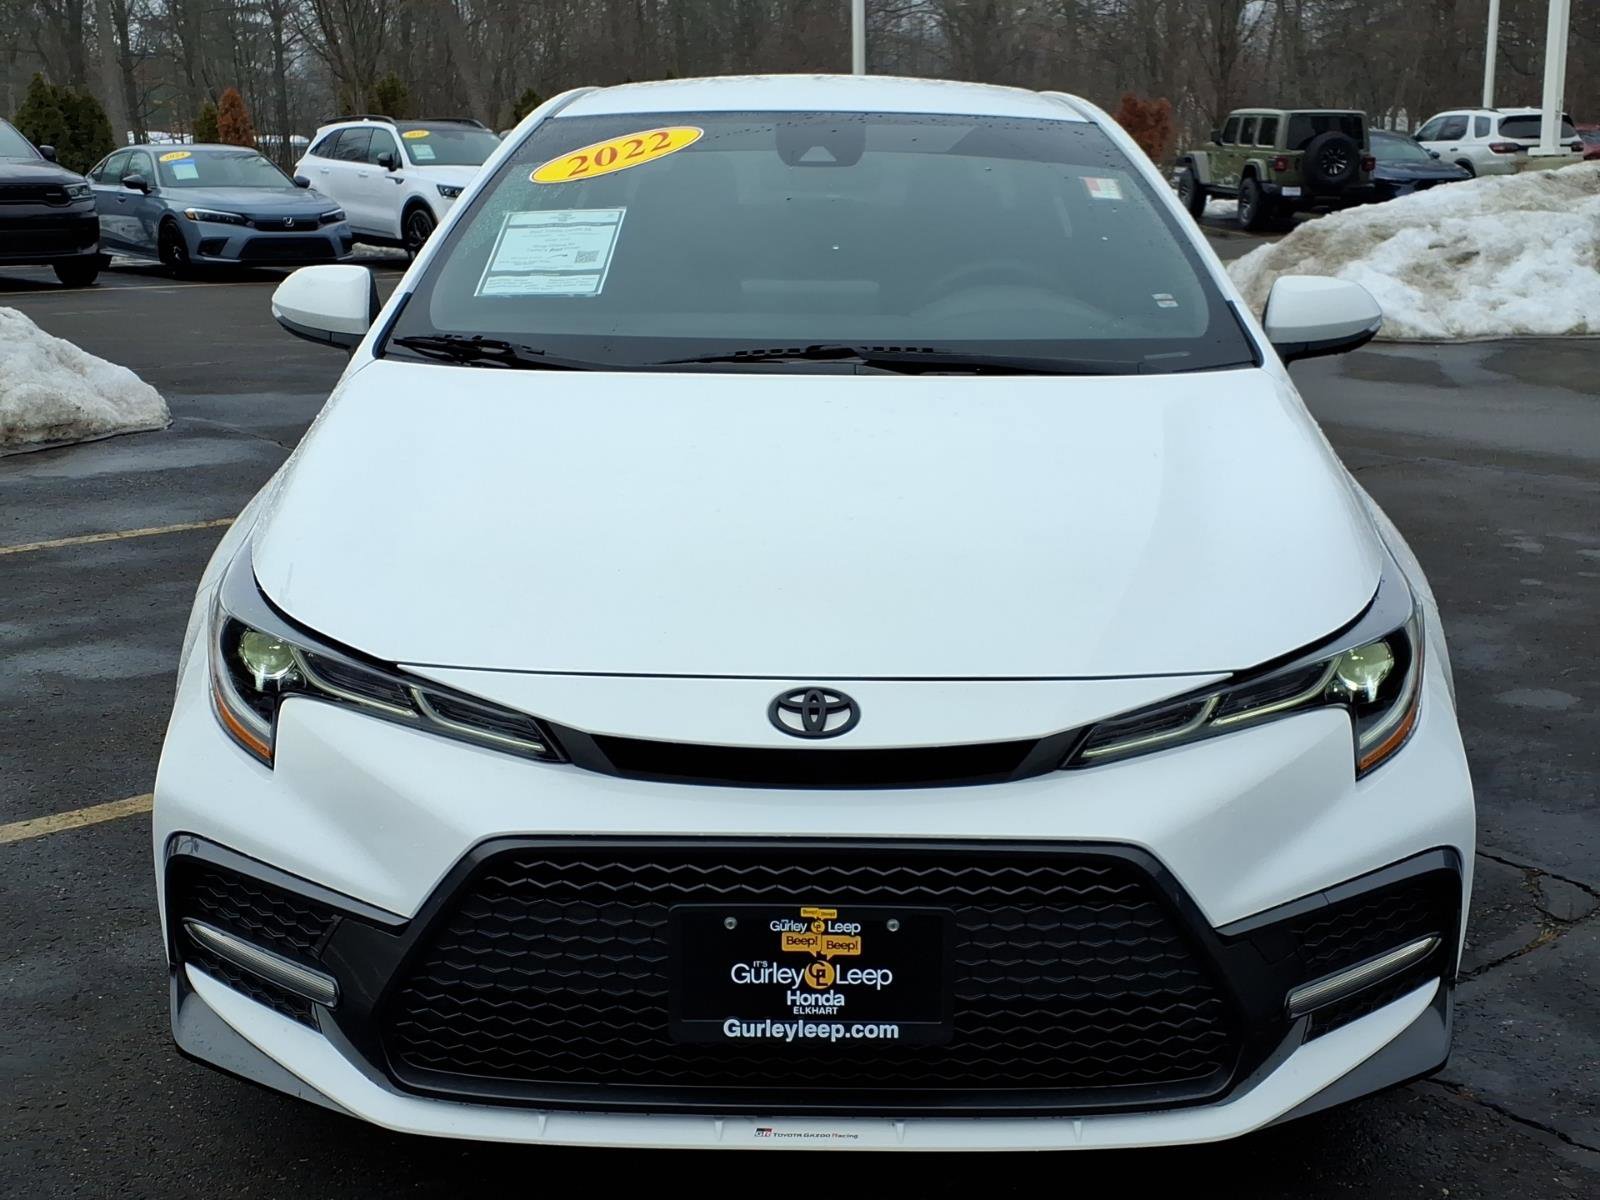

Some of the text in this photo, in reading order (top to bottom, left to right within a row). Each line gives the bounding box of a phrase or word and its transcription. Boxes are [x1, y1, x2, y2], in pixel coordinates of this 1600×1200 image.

[567, 131, 672, 177] 2022
[770, 920, 861, 935] Gurley Leep
[786, 936, 818, 947] Beep!
[826, 940, 858, 952] Beep!
[731, 962, 805, 989] Gurley
[836, 964, 893, 990] Leep
[787, 990, 845, 1006] Honda
[793, 1007, 838, 1015] ELKHART
[723, 1018, 899, 1042] Gurleyleep.com
